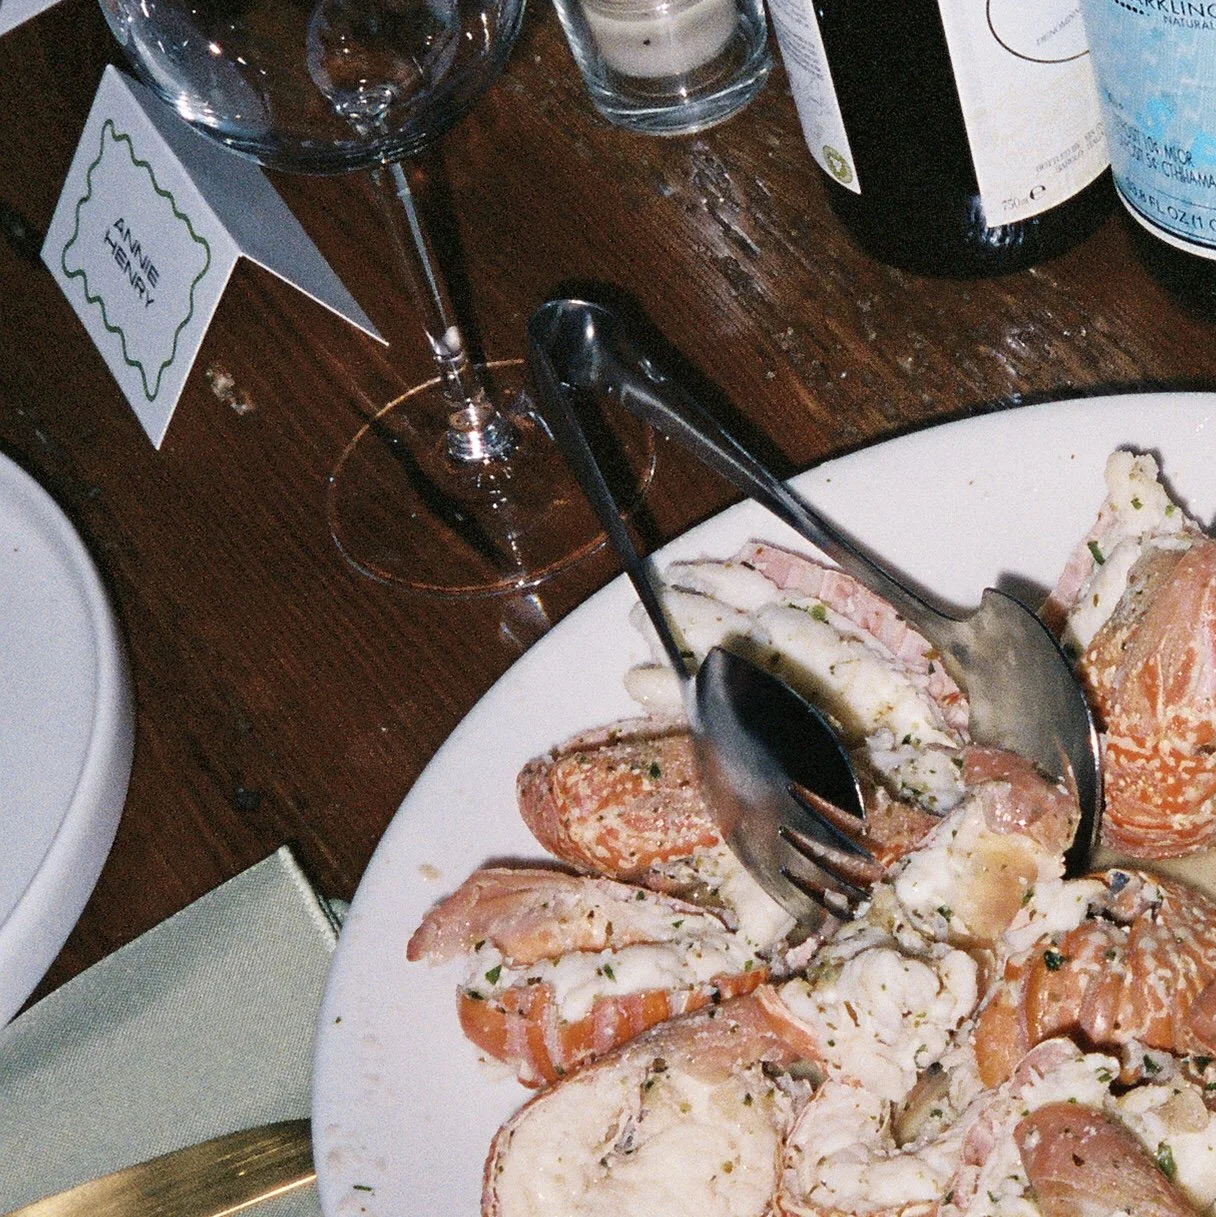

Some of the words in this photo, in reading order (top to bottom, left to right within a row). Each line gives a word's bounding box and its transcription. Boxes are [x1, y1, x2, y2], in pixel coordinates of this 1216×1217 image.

[1163, 15, 1215, 31] NATURAL
[1149, 195, 1165, 215] FL
[1167, 206, 1190, 225] OZ
[1192, 214, 1204, 230] (1
[104, 229, 155, 309] HENRY
[113, 217, 160, 288] ANNIE
